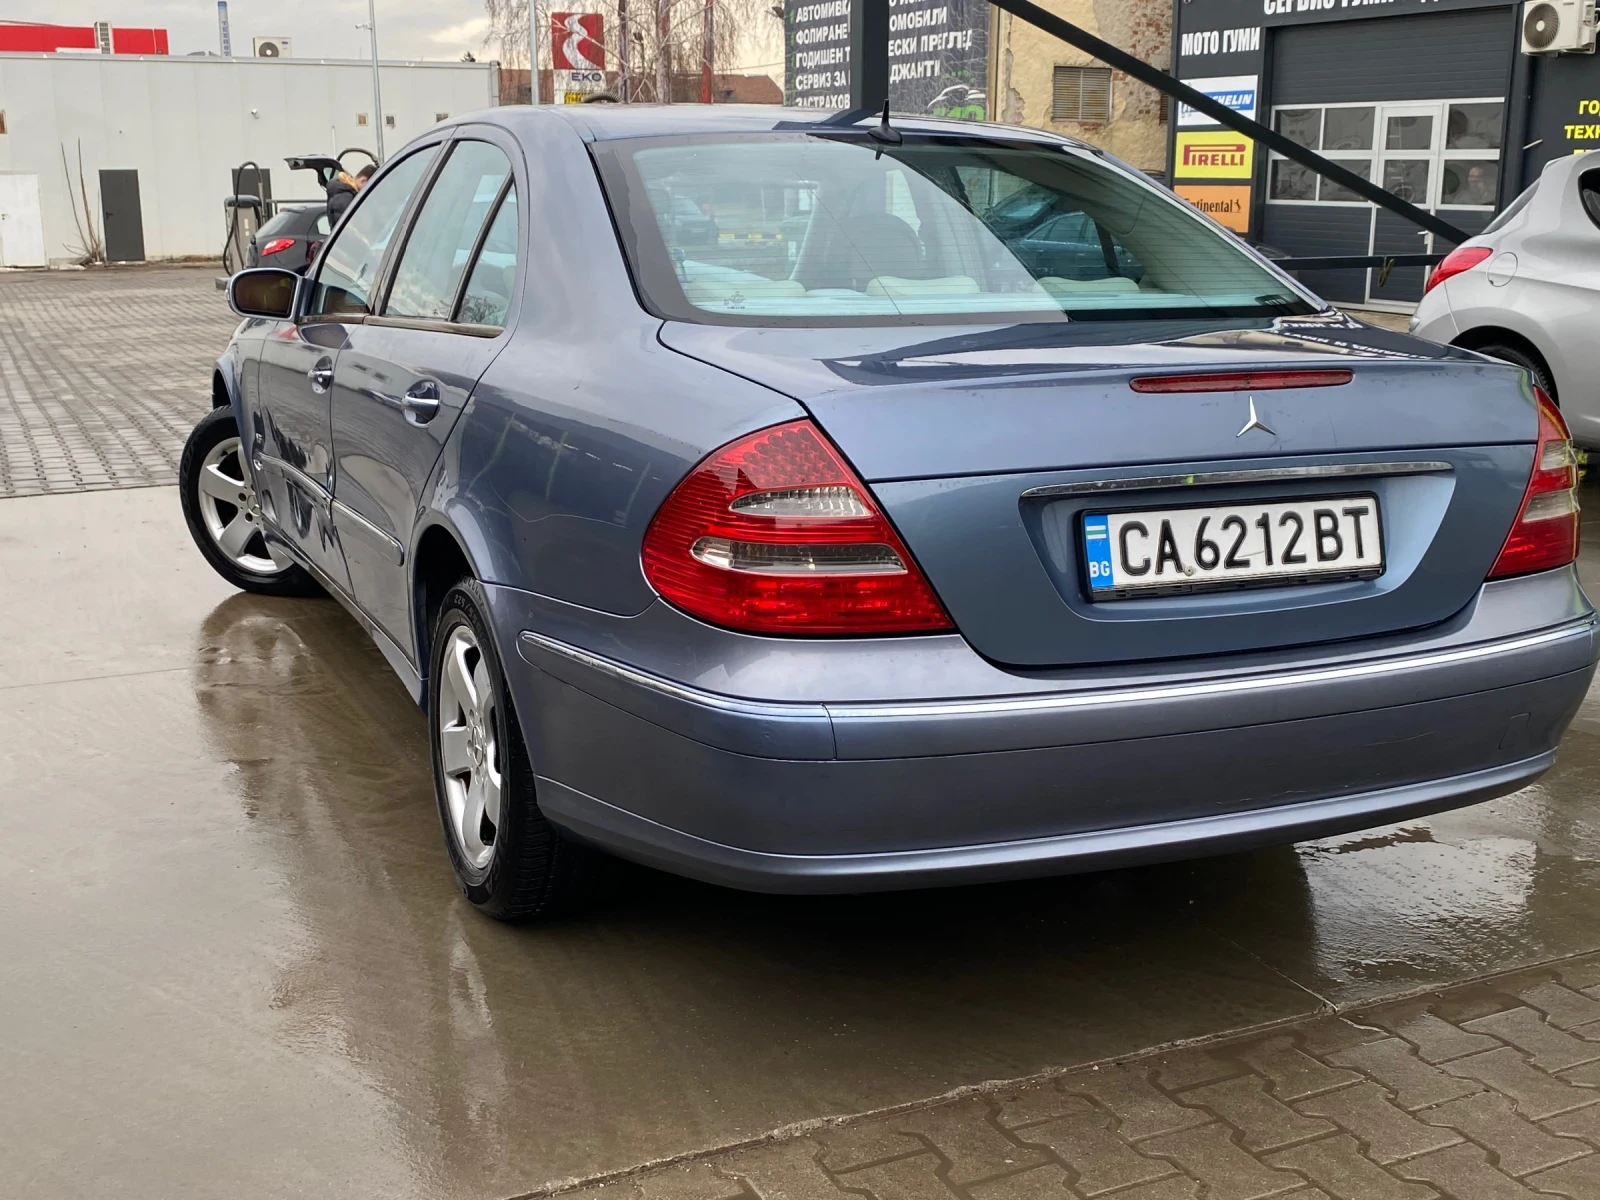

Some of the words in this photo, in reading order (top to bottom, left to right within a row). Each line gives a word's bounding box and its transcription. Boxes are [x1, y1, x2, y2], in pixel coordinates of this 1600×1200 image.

[796, 48, 843, 69] ГОДИШЕН
[921, 30, 972, 50] ПРЕГЛЕД
[1181, 31, 1219, 56] МОТО
[1222, 27, 1260, 53] ГУМИ
[571, 72, 602, 82] EKO
[796, 72, 831, 90] СЕРВИЗ
[834, 71, 846, 87] ЗА
[890, 60, 940, 84] ДЖАНТИ
[1211, 94, 1253, 106] HELIN
[1579, 100, 1600, 117] ГО
[1183, 144, 1246, 166] PIRELLI
[1184, 198, 1233, 212] tinental
[1089, 560, 1111, 578] BG
